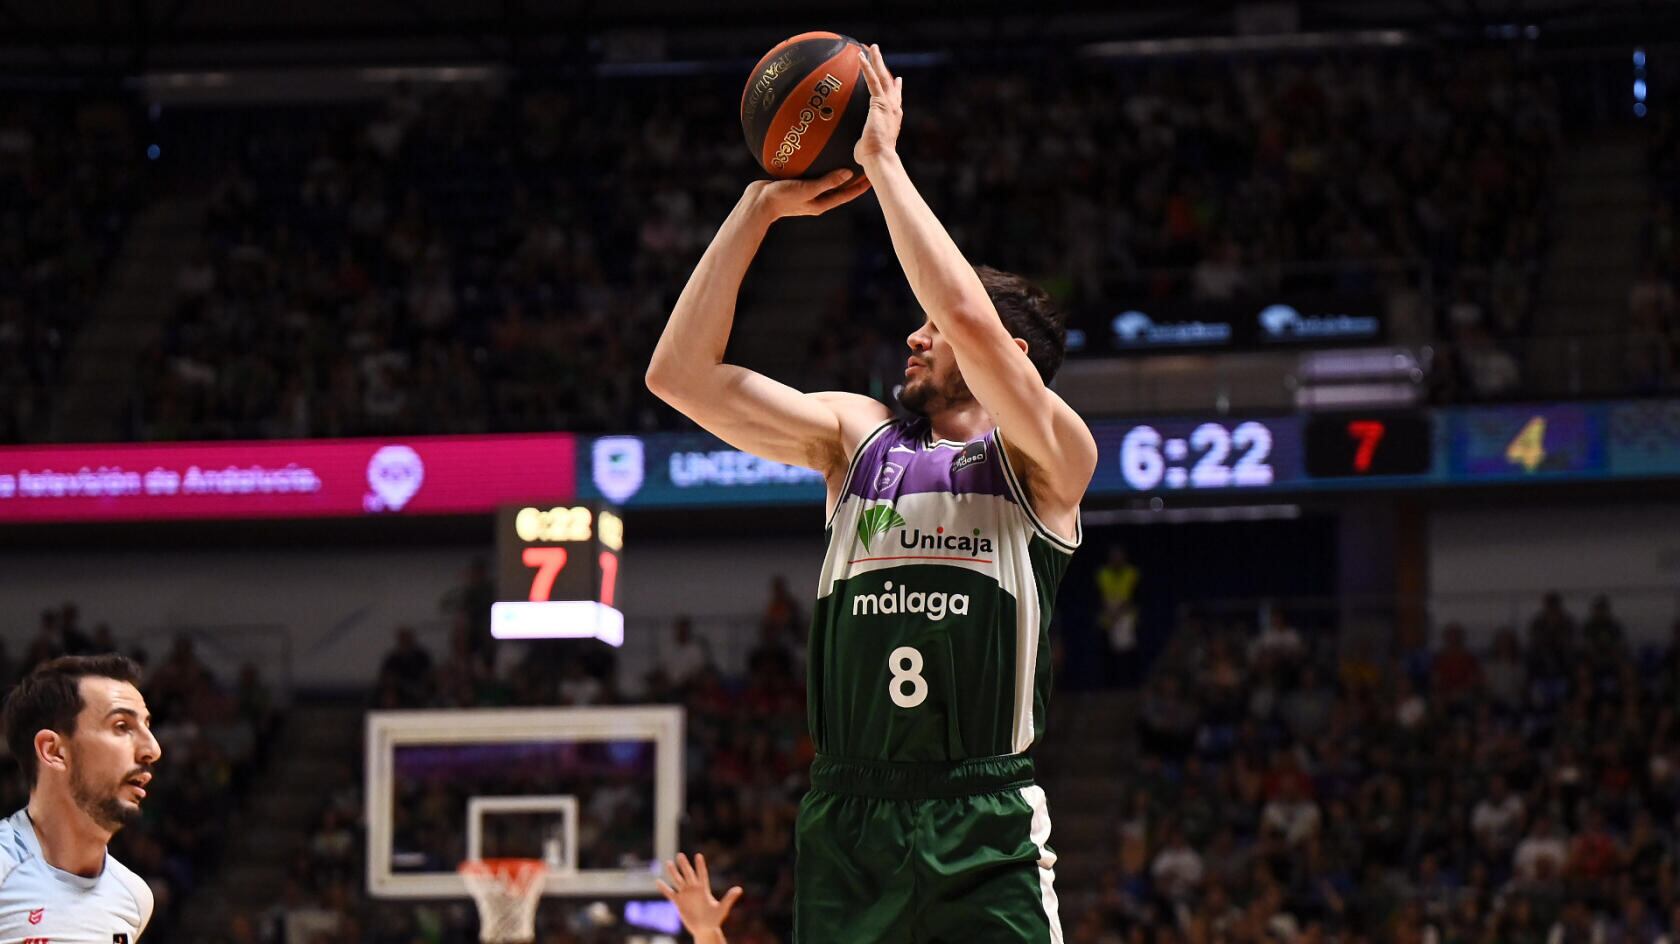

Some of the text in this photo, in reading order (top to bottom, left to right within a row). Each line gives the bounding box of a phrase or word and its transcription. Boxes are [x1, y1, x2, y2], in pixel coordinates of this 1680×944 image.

[1120, 421, 1273, 490] 6:22
[1348, 421, 1385, 472] 7
[1506, 416, 1547, 472] 4
[900, 527, 993, 556] Unicaja
[522, 547, 568, 602] 7
[889, 646, 928, 708] 8
